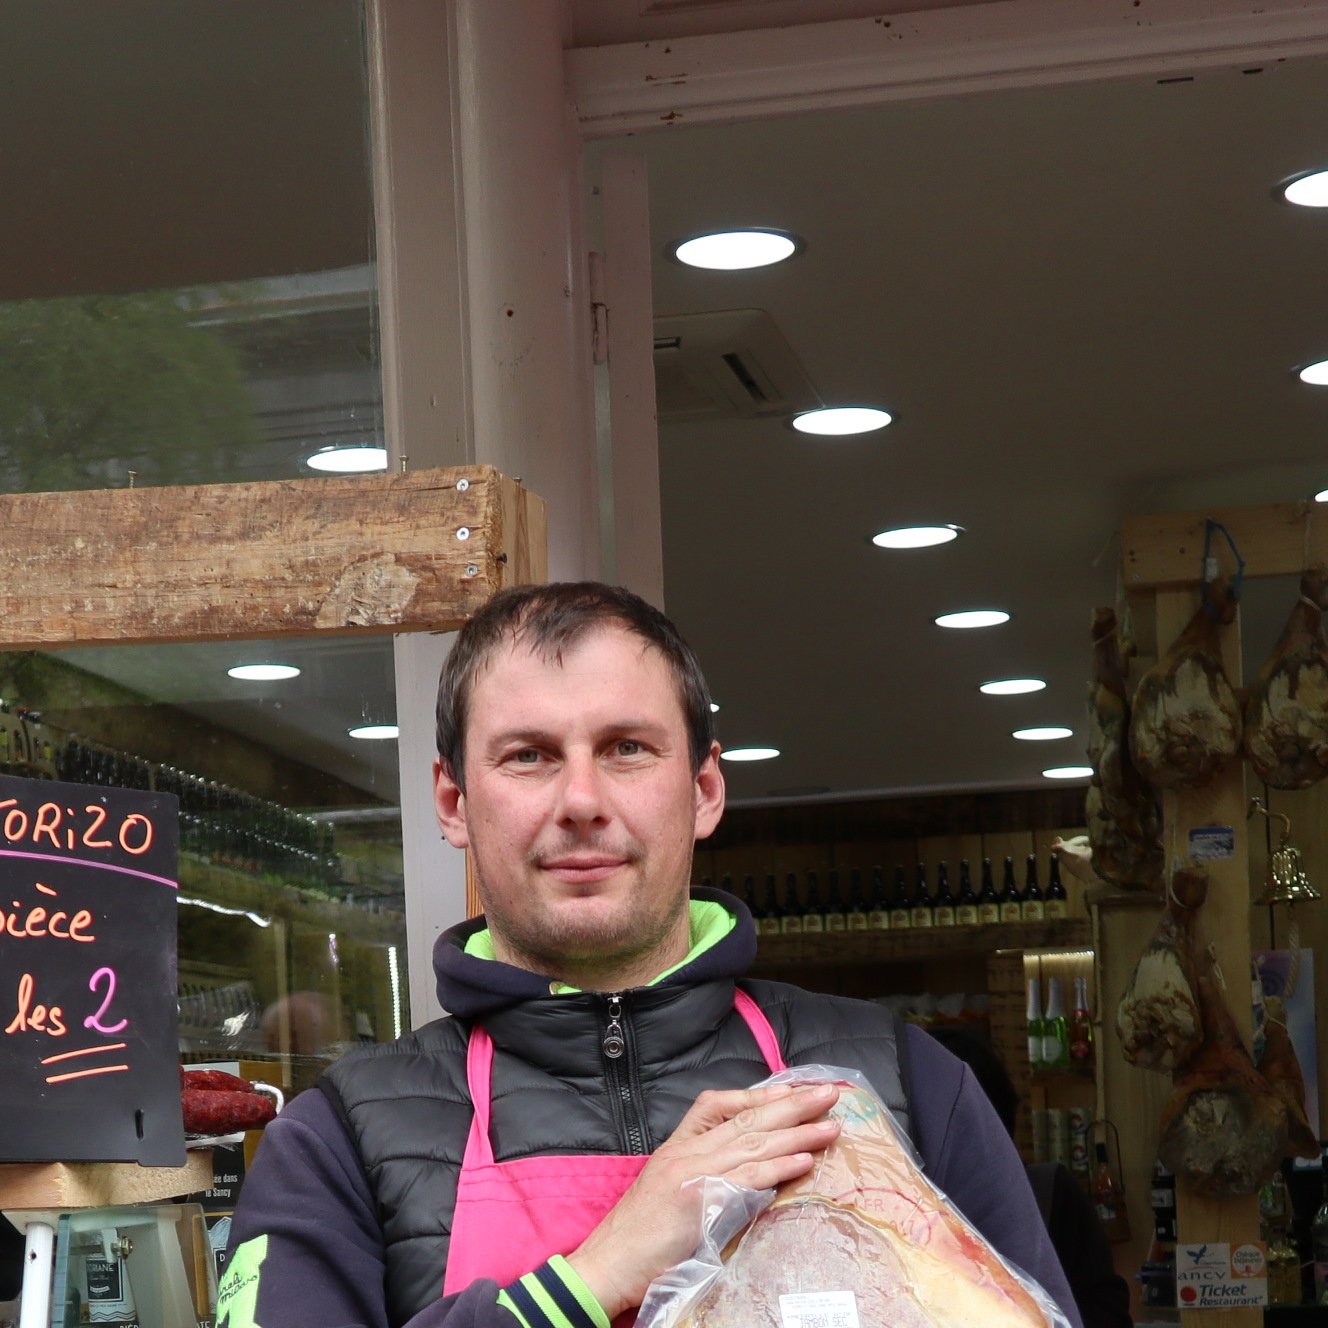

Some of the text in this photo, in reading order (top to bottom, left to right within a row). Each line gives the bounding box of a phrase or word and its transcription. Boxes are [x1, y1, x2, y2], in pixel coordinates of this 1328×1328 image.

[4, 973, 67, 1036] les
[83, 967, 128, 1033] 2
[222, 1173, 239, 1183] dans
[212, 1187, 232, 1198] Sancy
[1177, 1270, 1227, 1281] ancv
[1200, 1284, 1248, 1297] Ticket
[832, 1316, 848, 1328] SEC
